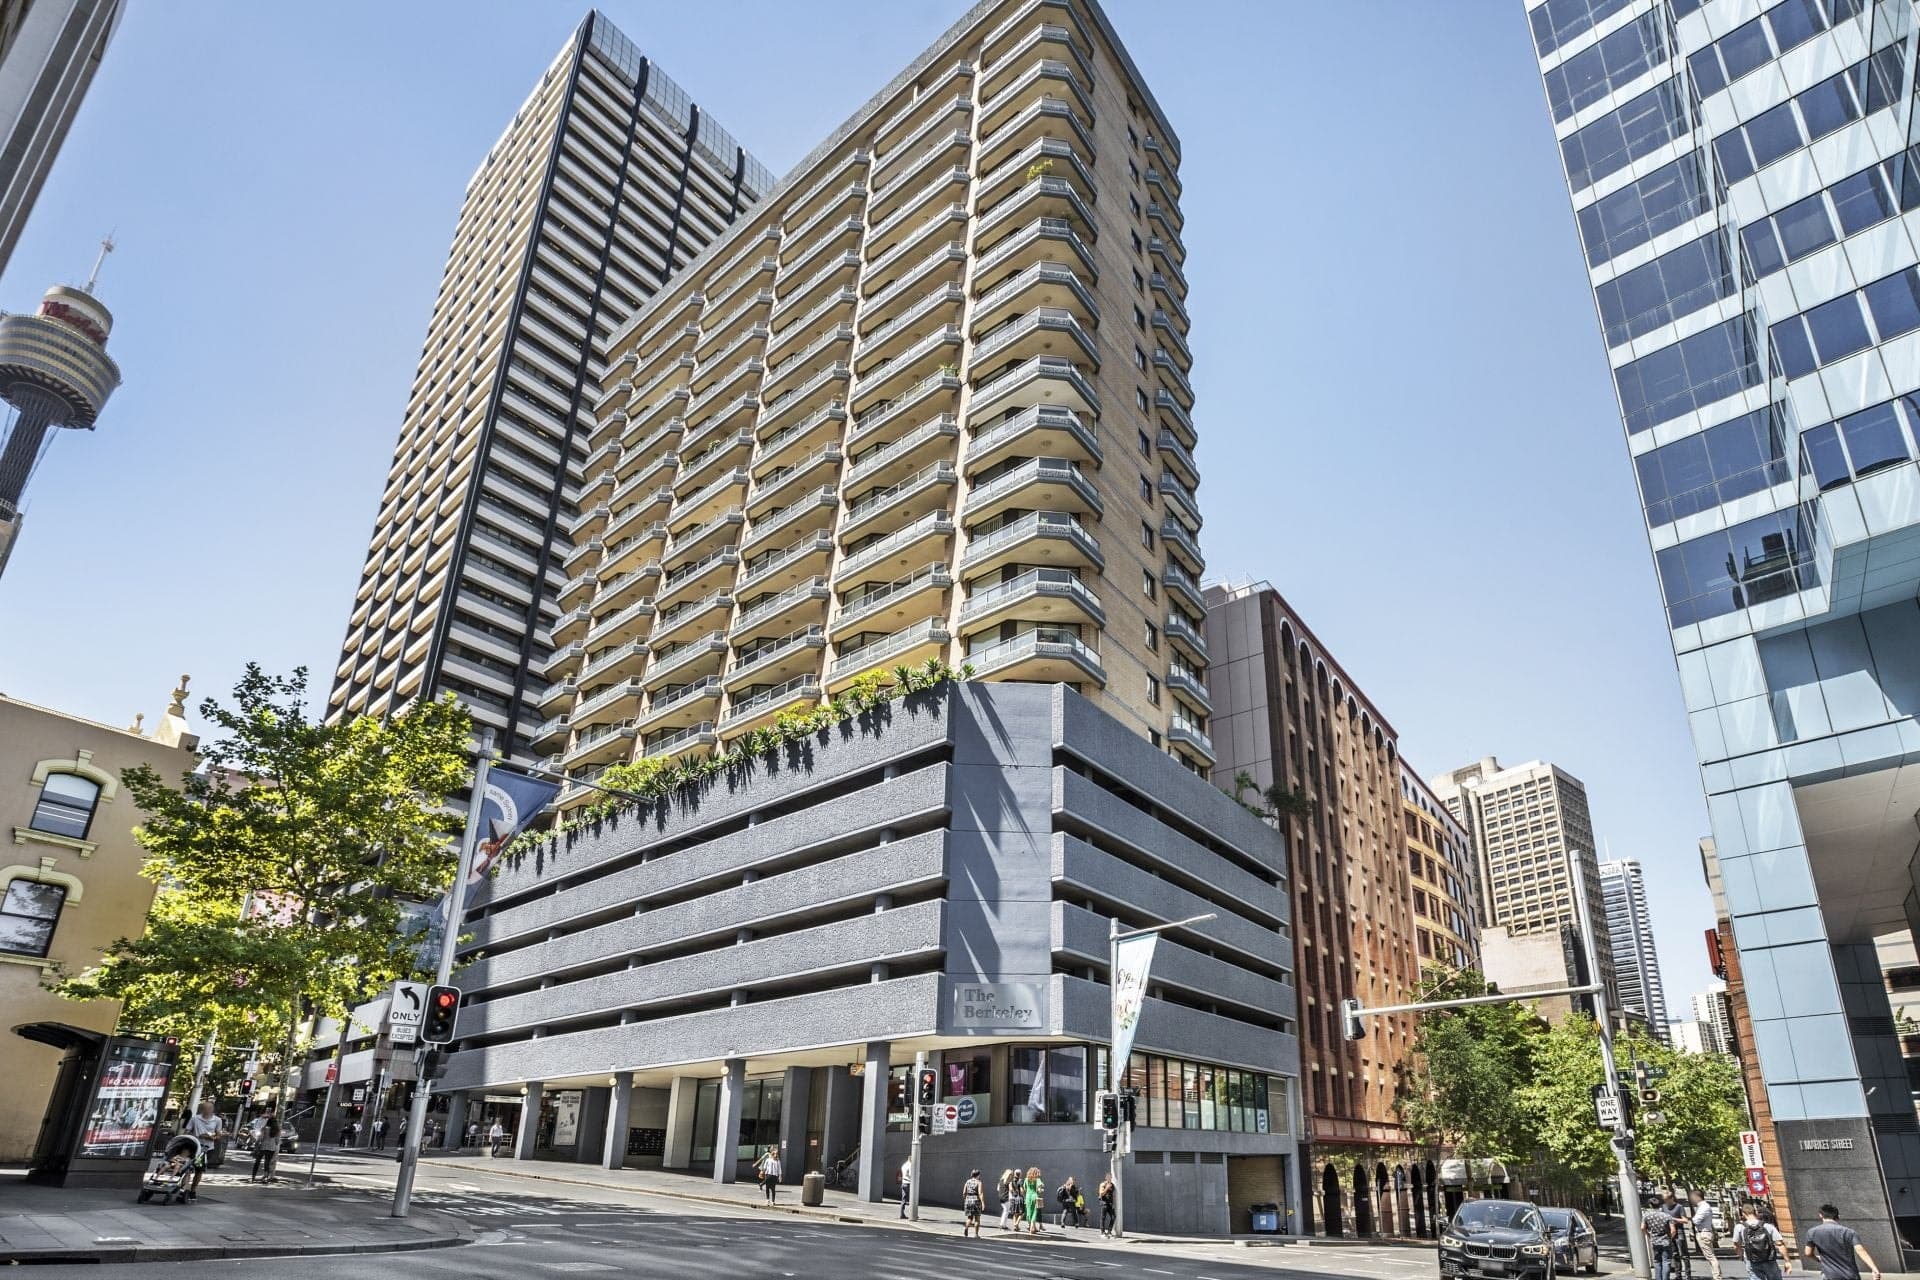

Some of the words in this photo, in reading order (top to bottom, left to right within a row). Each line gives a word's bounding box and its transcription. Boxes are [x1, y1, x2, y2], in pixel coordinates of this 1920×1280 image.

[964, 988, 994, 1001] The
[392, 1011, 420, 1022] ONLY
[964, 1005, 1032, 1022] Berkeley
[1803, 1139, 1829, 1150] MARKET
[1830, 1138, 1853, 1149] STREET
[1747, 1144, 1756, 1166] Wilson
